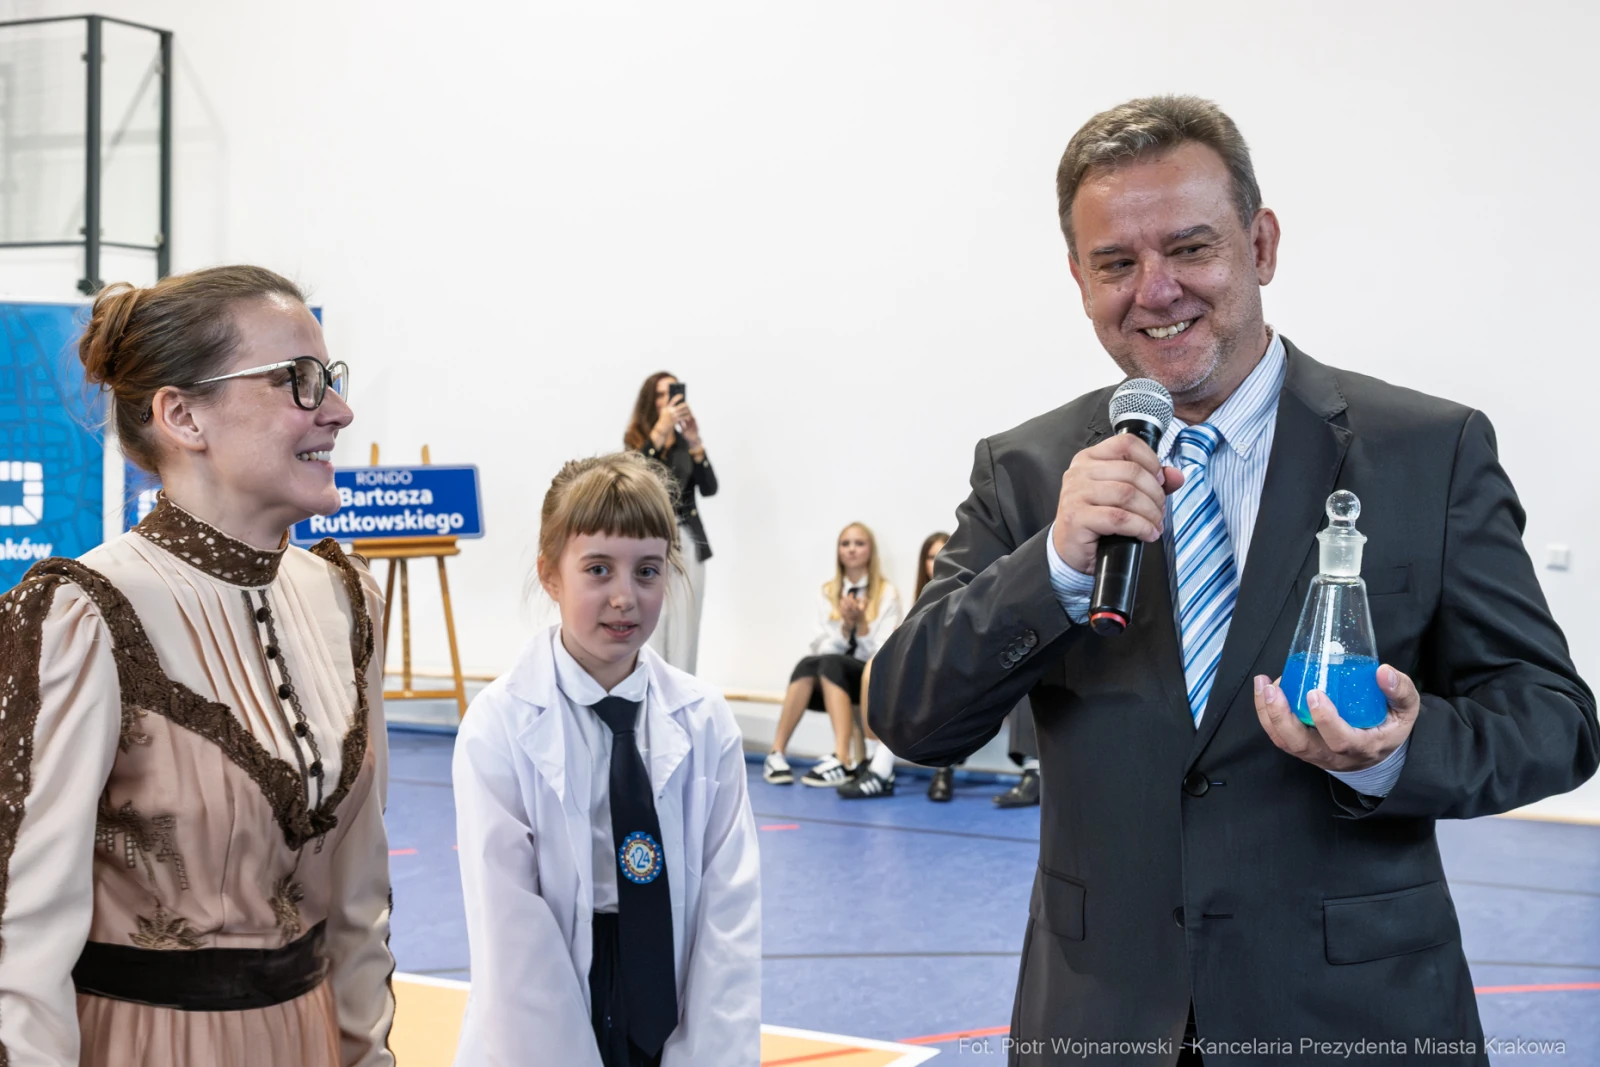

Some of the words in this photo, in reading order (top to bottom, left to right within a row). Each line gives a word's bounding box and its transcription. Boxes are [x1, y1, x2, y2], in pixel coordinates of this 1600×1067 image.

[355, 471, 413, 486] RONDO
[340, 487, 434, 507] Bartosza
[309, 508, 464, 535] Rutkowskiego
[630, 846, 650, 869] 124
